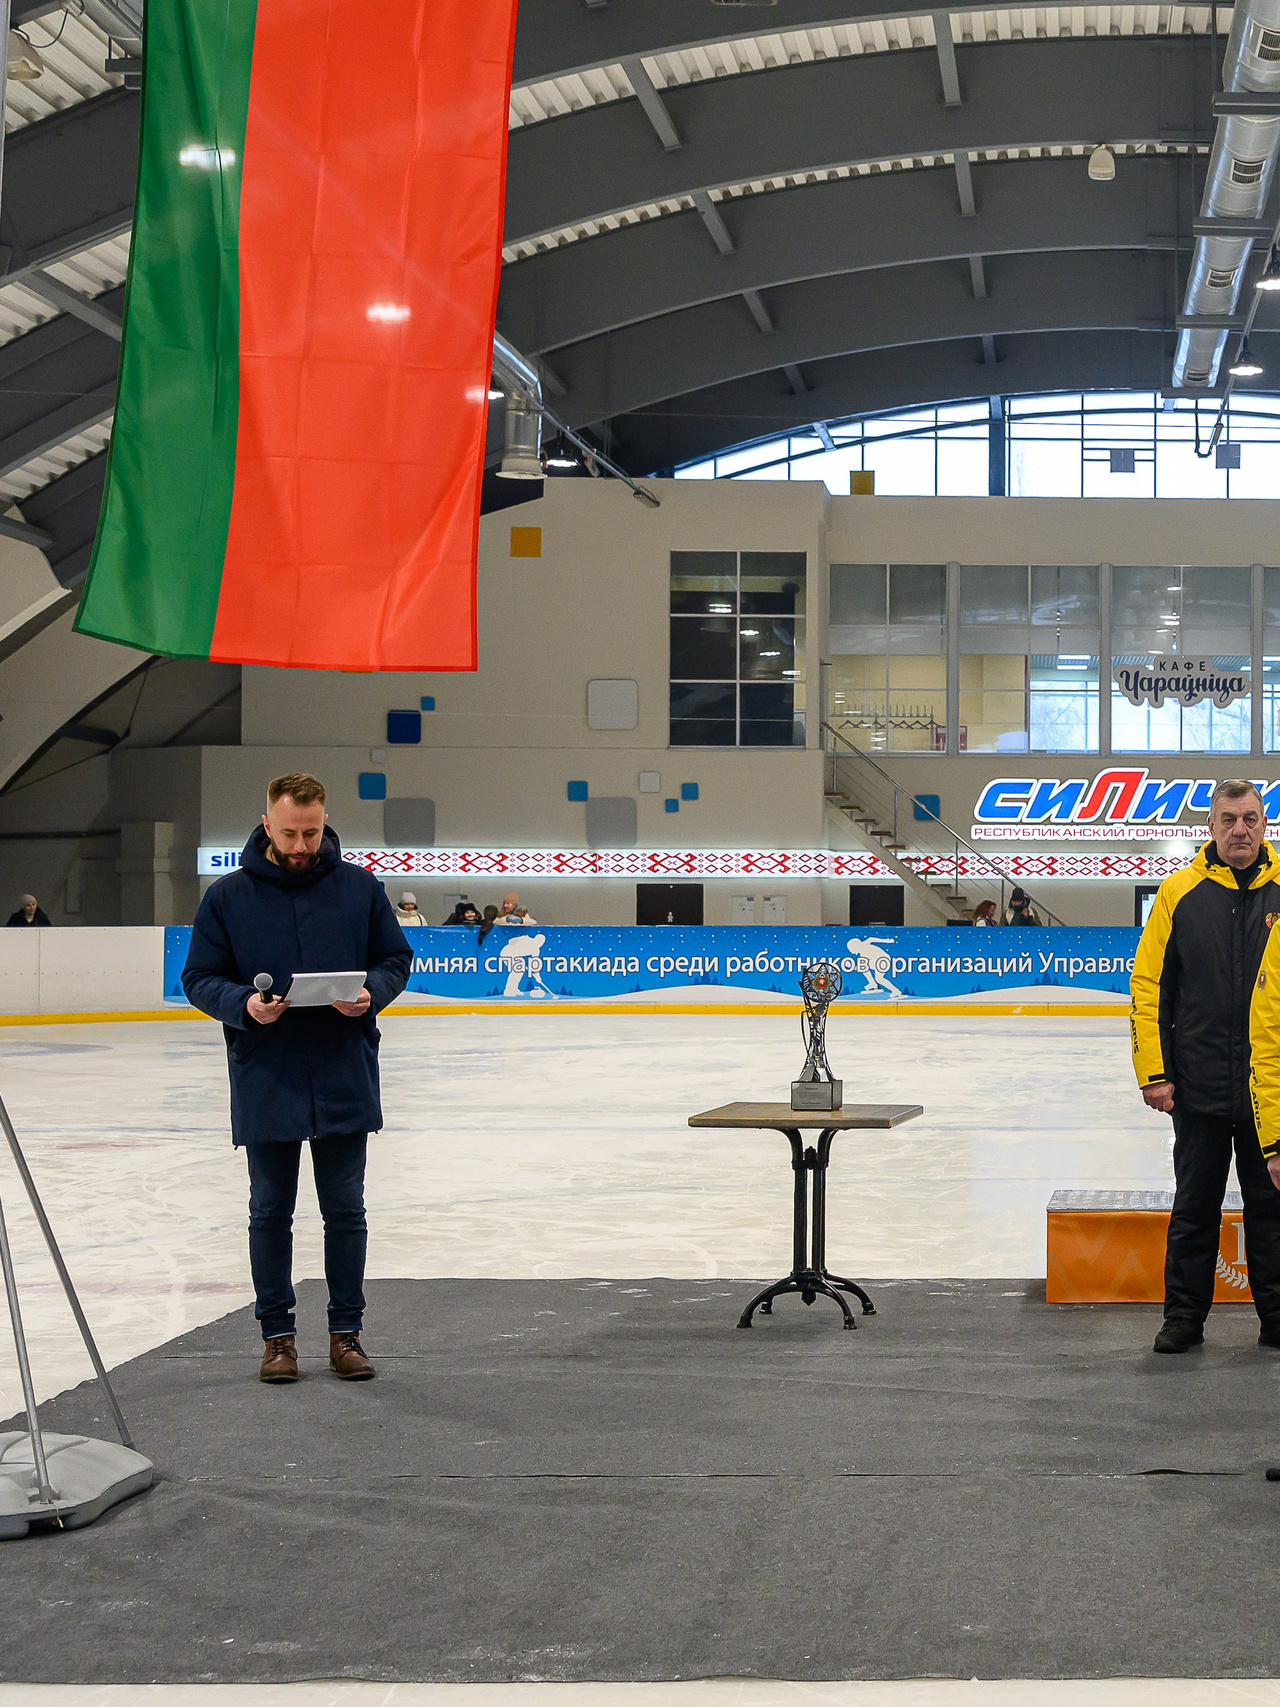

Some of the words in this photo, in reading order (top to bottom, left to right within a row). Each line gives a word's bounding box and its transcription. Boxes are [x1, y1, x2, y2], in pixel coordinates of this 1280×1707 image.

[1158, 661, 1206, 672] КАФЕ
[974, 824, 1125, 838] РЕСПУБЛИКАНСКИЙ
[484, 955, 640, 978] спартакиада
[646, 954, 719, 978] среди
[875, 951, 1033, 981] организаций
